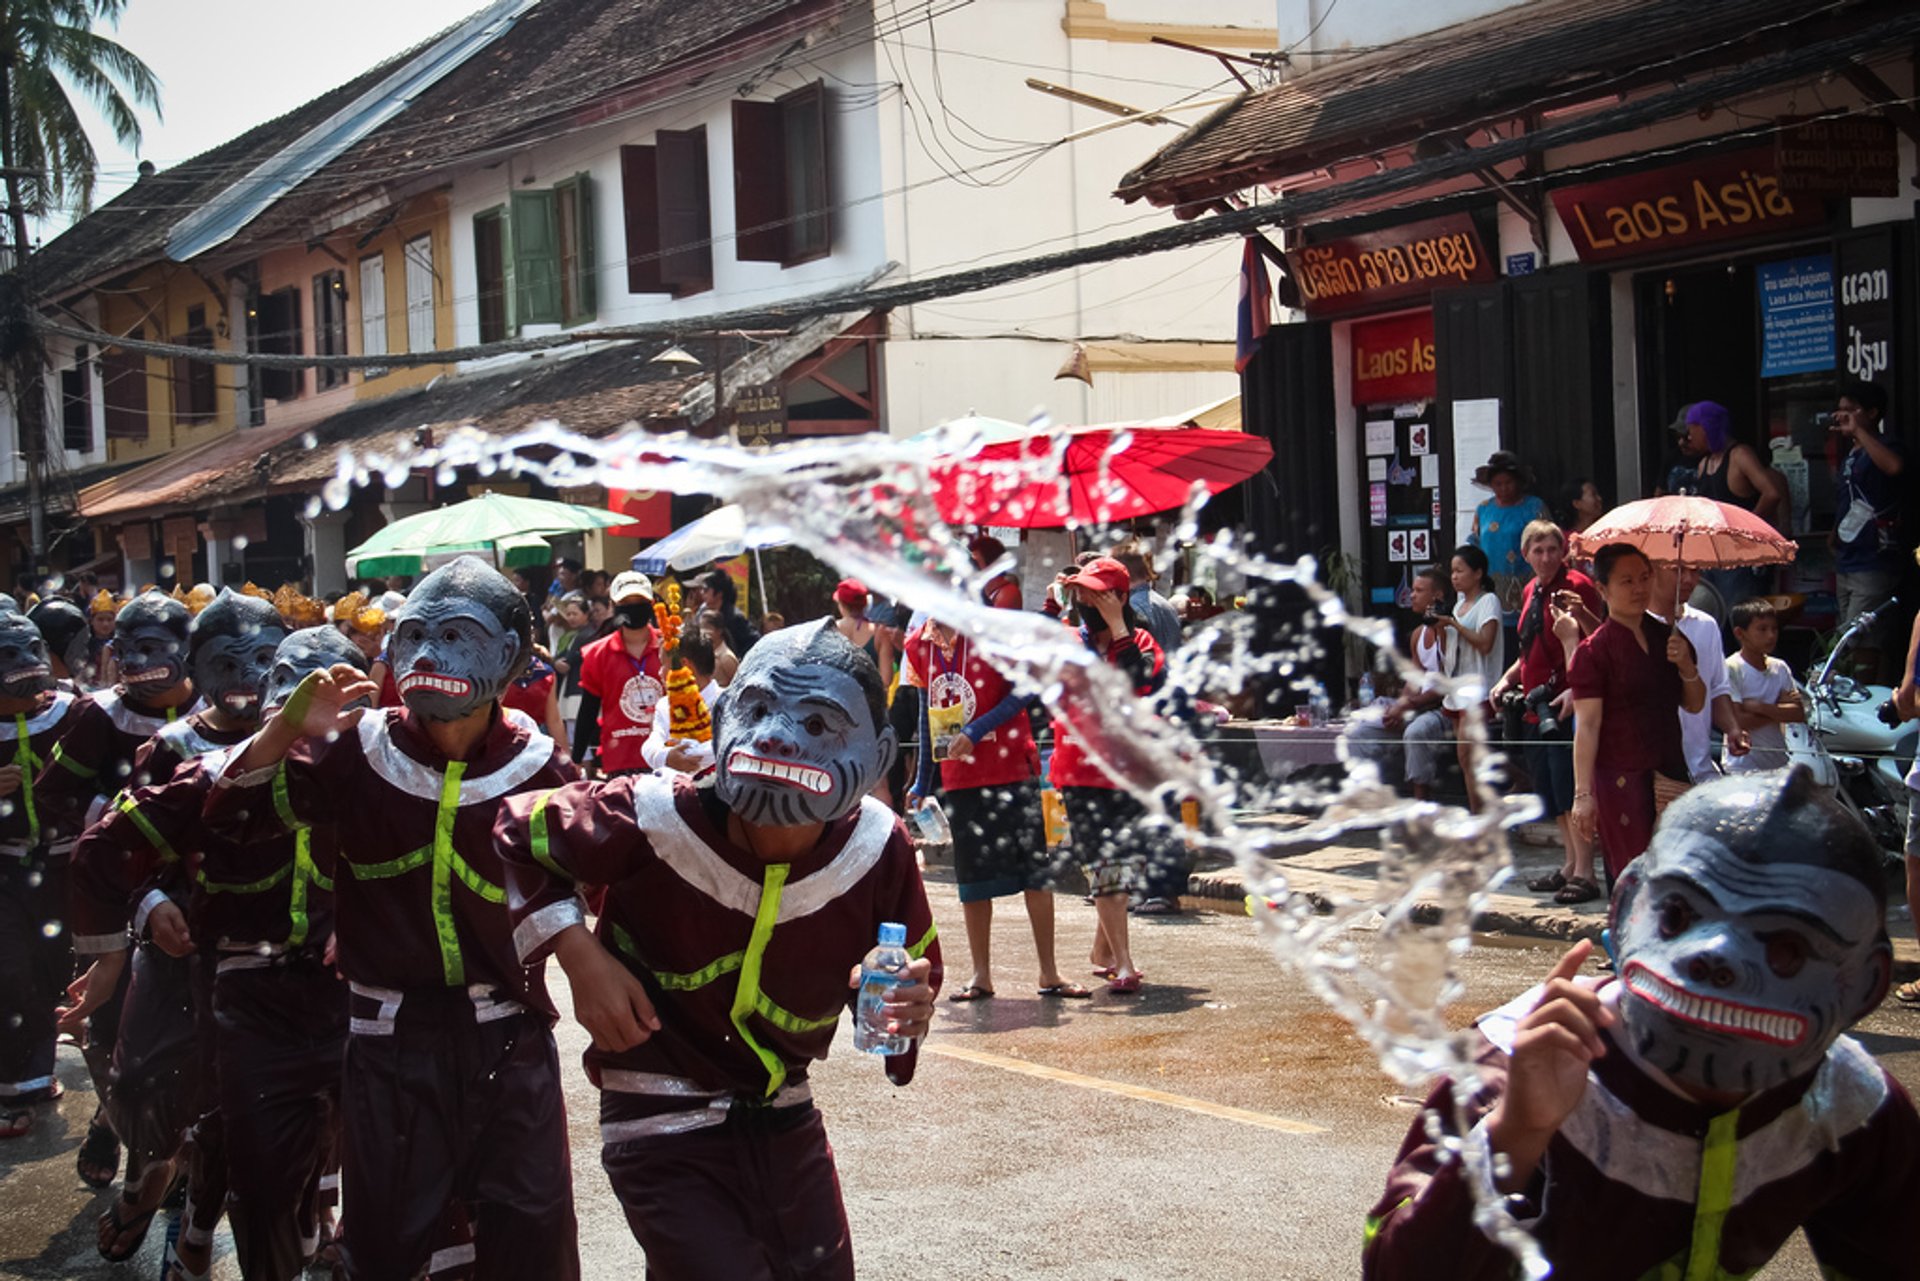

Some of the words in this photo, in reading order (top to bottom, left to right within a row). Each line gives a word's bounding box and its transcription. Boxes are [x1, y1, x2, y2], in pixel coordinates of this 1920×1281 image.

[1572, 195, 1689, 249] Laos
[1693, 169, 1794, 231] Asia
[1359, 247, 1410, 289] ລາວ
[1841, 268, 1888, 305] ແລກ
[1356, 347, 1408, 381] Laos
[1846, 325, 1888, 382] ປ່ຽນ
